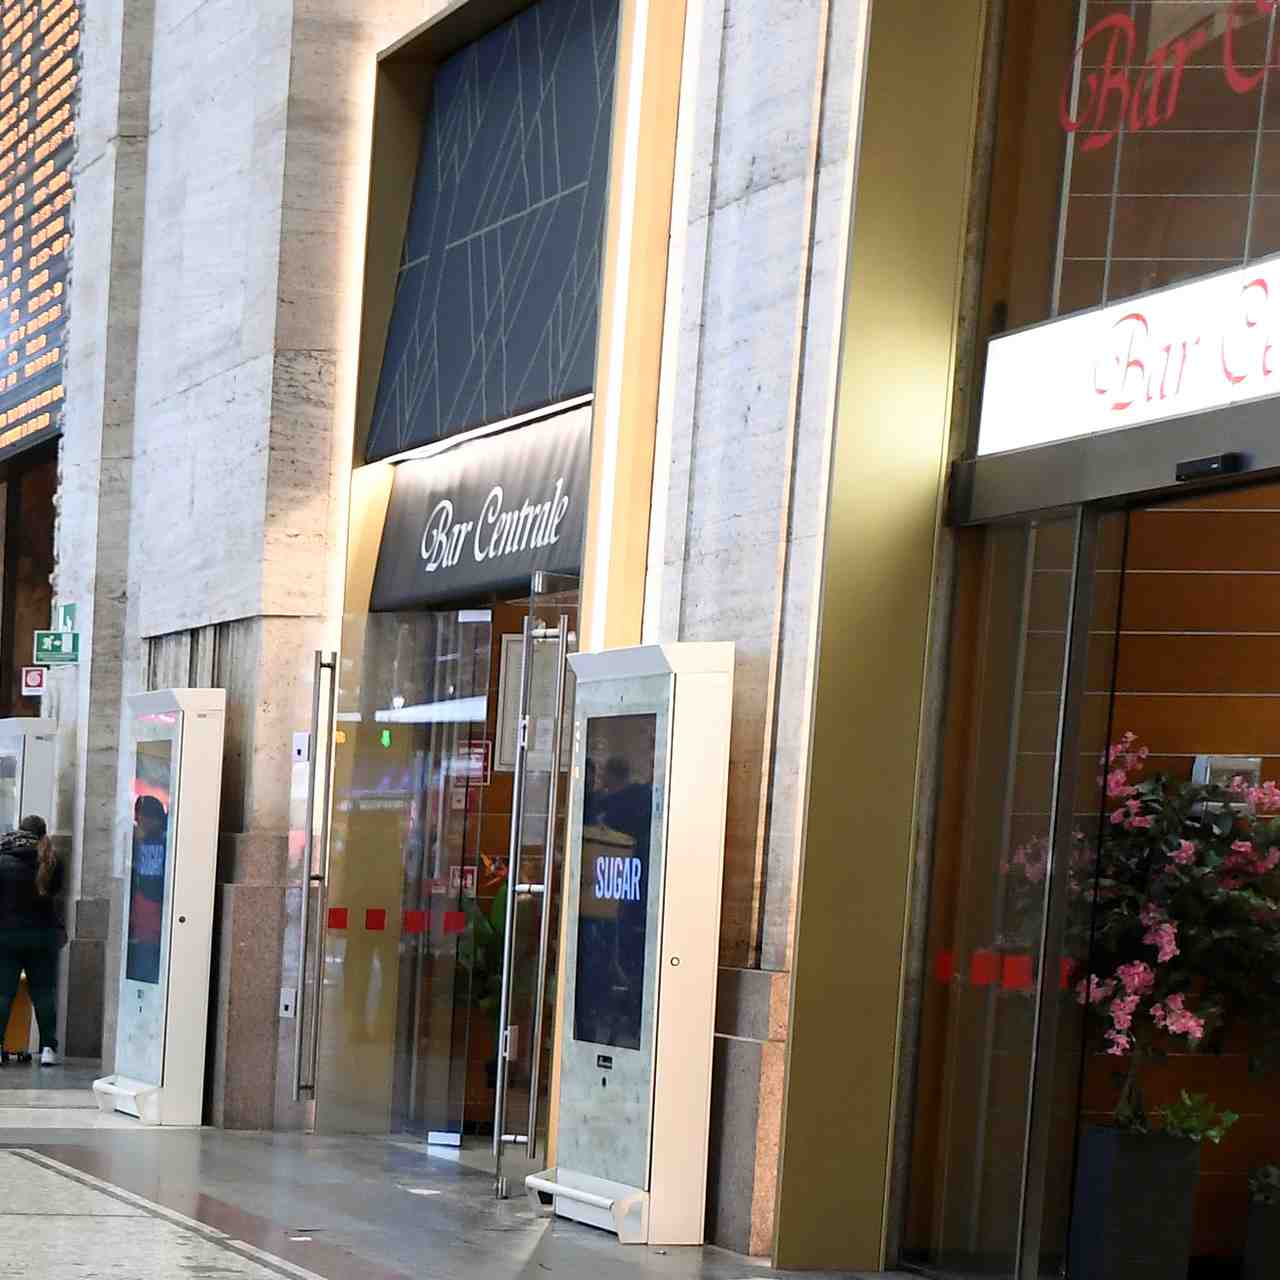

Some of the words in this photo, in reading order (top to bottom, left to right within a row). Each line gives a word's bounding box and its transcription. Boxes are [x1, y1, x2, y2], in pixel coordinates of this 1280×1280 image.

[1060, 14, 1206, 152] Bar
[1092, 313, 1201, 411] Bar
[421, 499, 473, 572] Bar
[474, 477, 569, 562] Centrale
[595, 856, 642, 901] SUGAR
